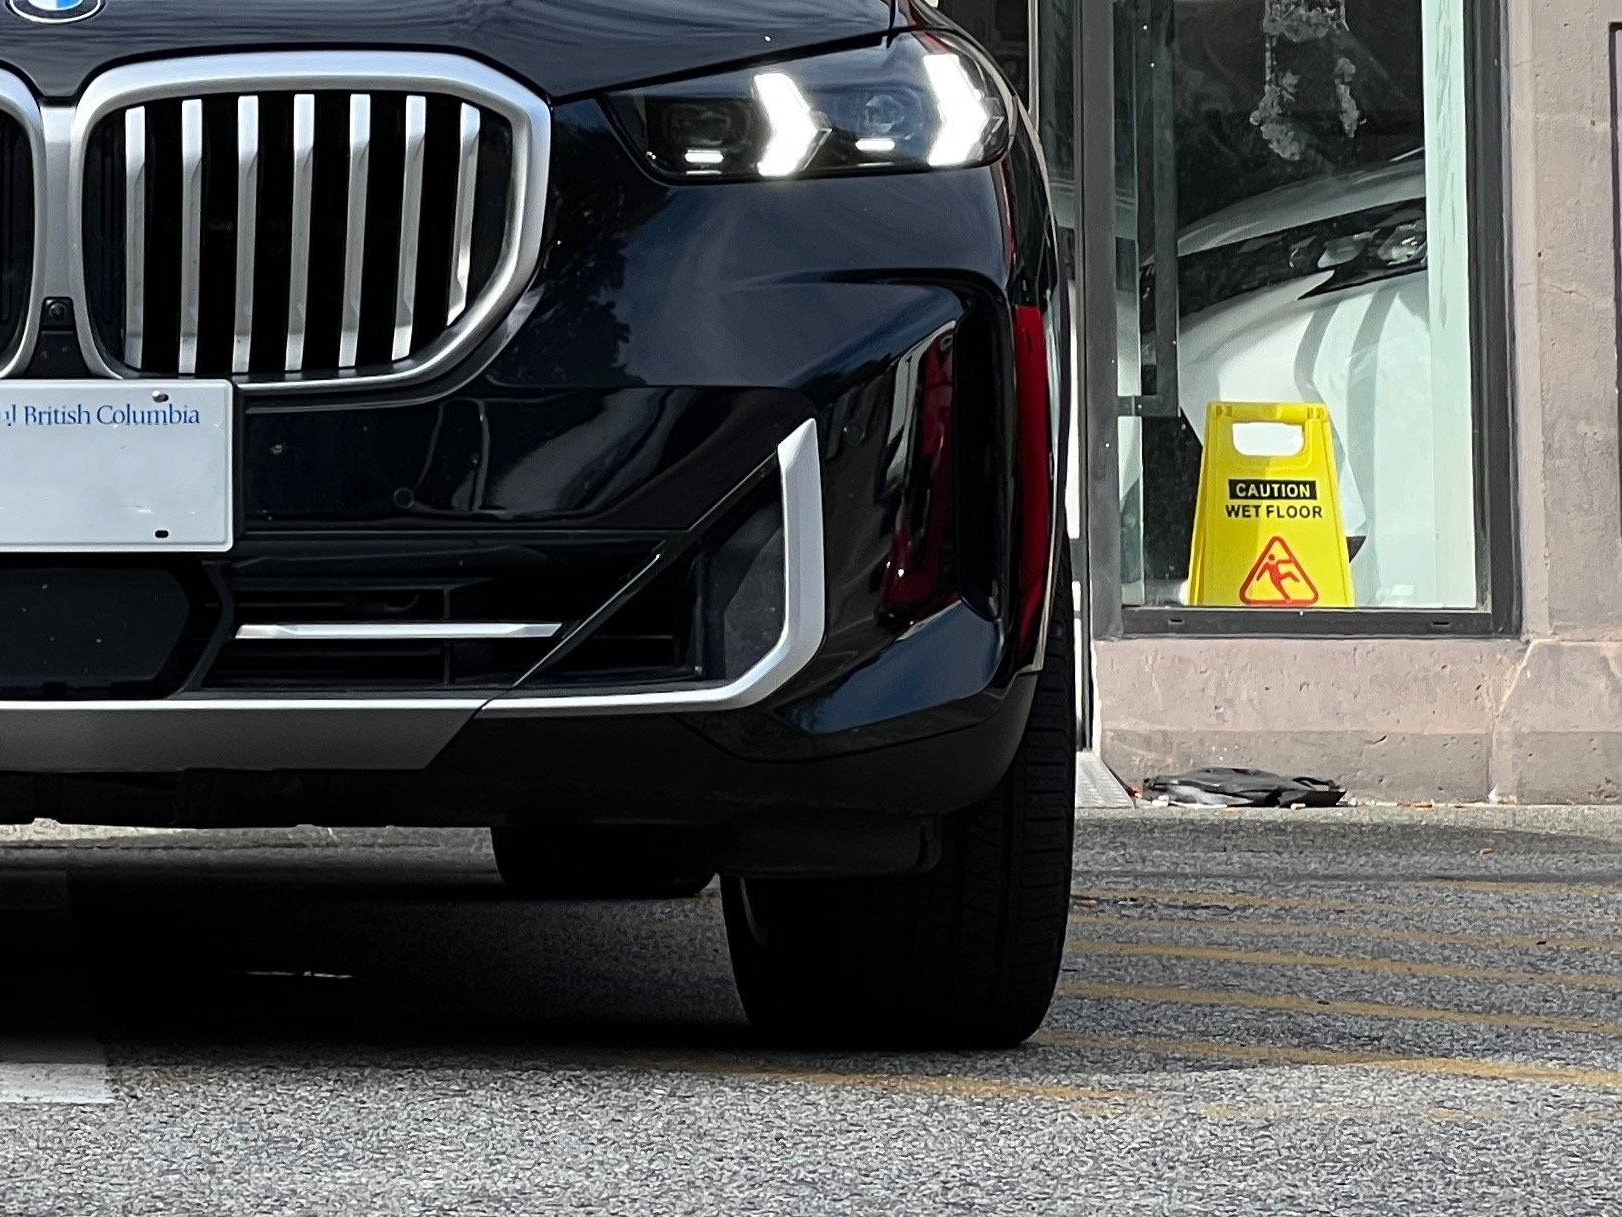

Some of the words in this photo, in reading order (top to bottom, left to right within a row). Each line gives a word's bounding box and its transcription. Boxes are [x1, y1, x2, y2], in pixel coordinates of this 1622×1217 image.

[24, 404, 91, 426] British
[96, 403, 200, 426] Columbia
[1235, 483, 1311, 498] CAUTION
[1225, 504, 1261, 519] WET
[1266, 505, 1323, 519] FLOOR
